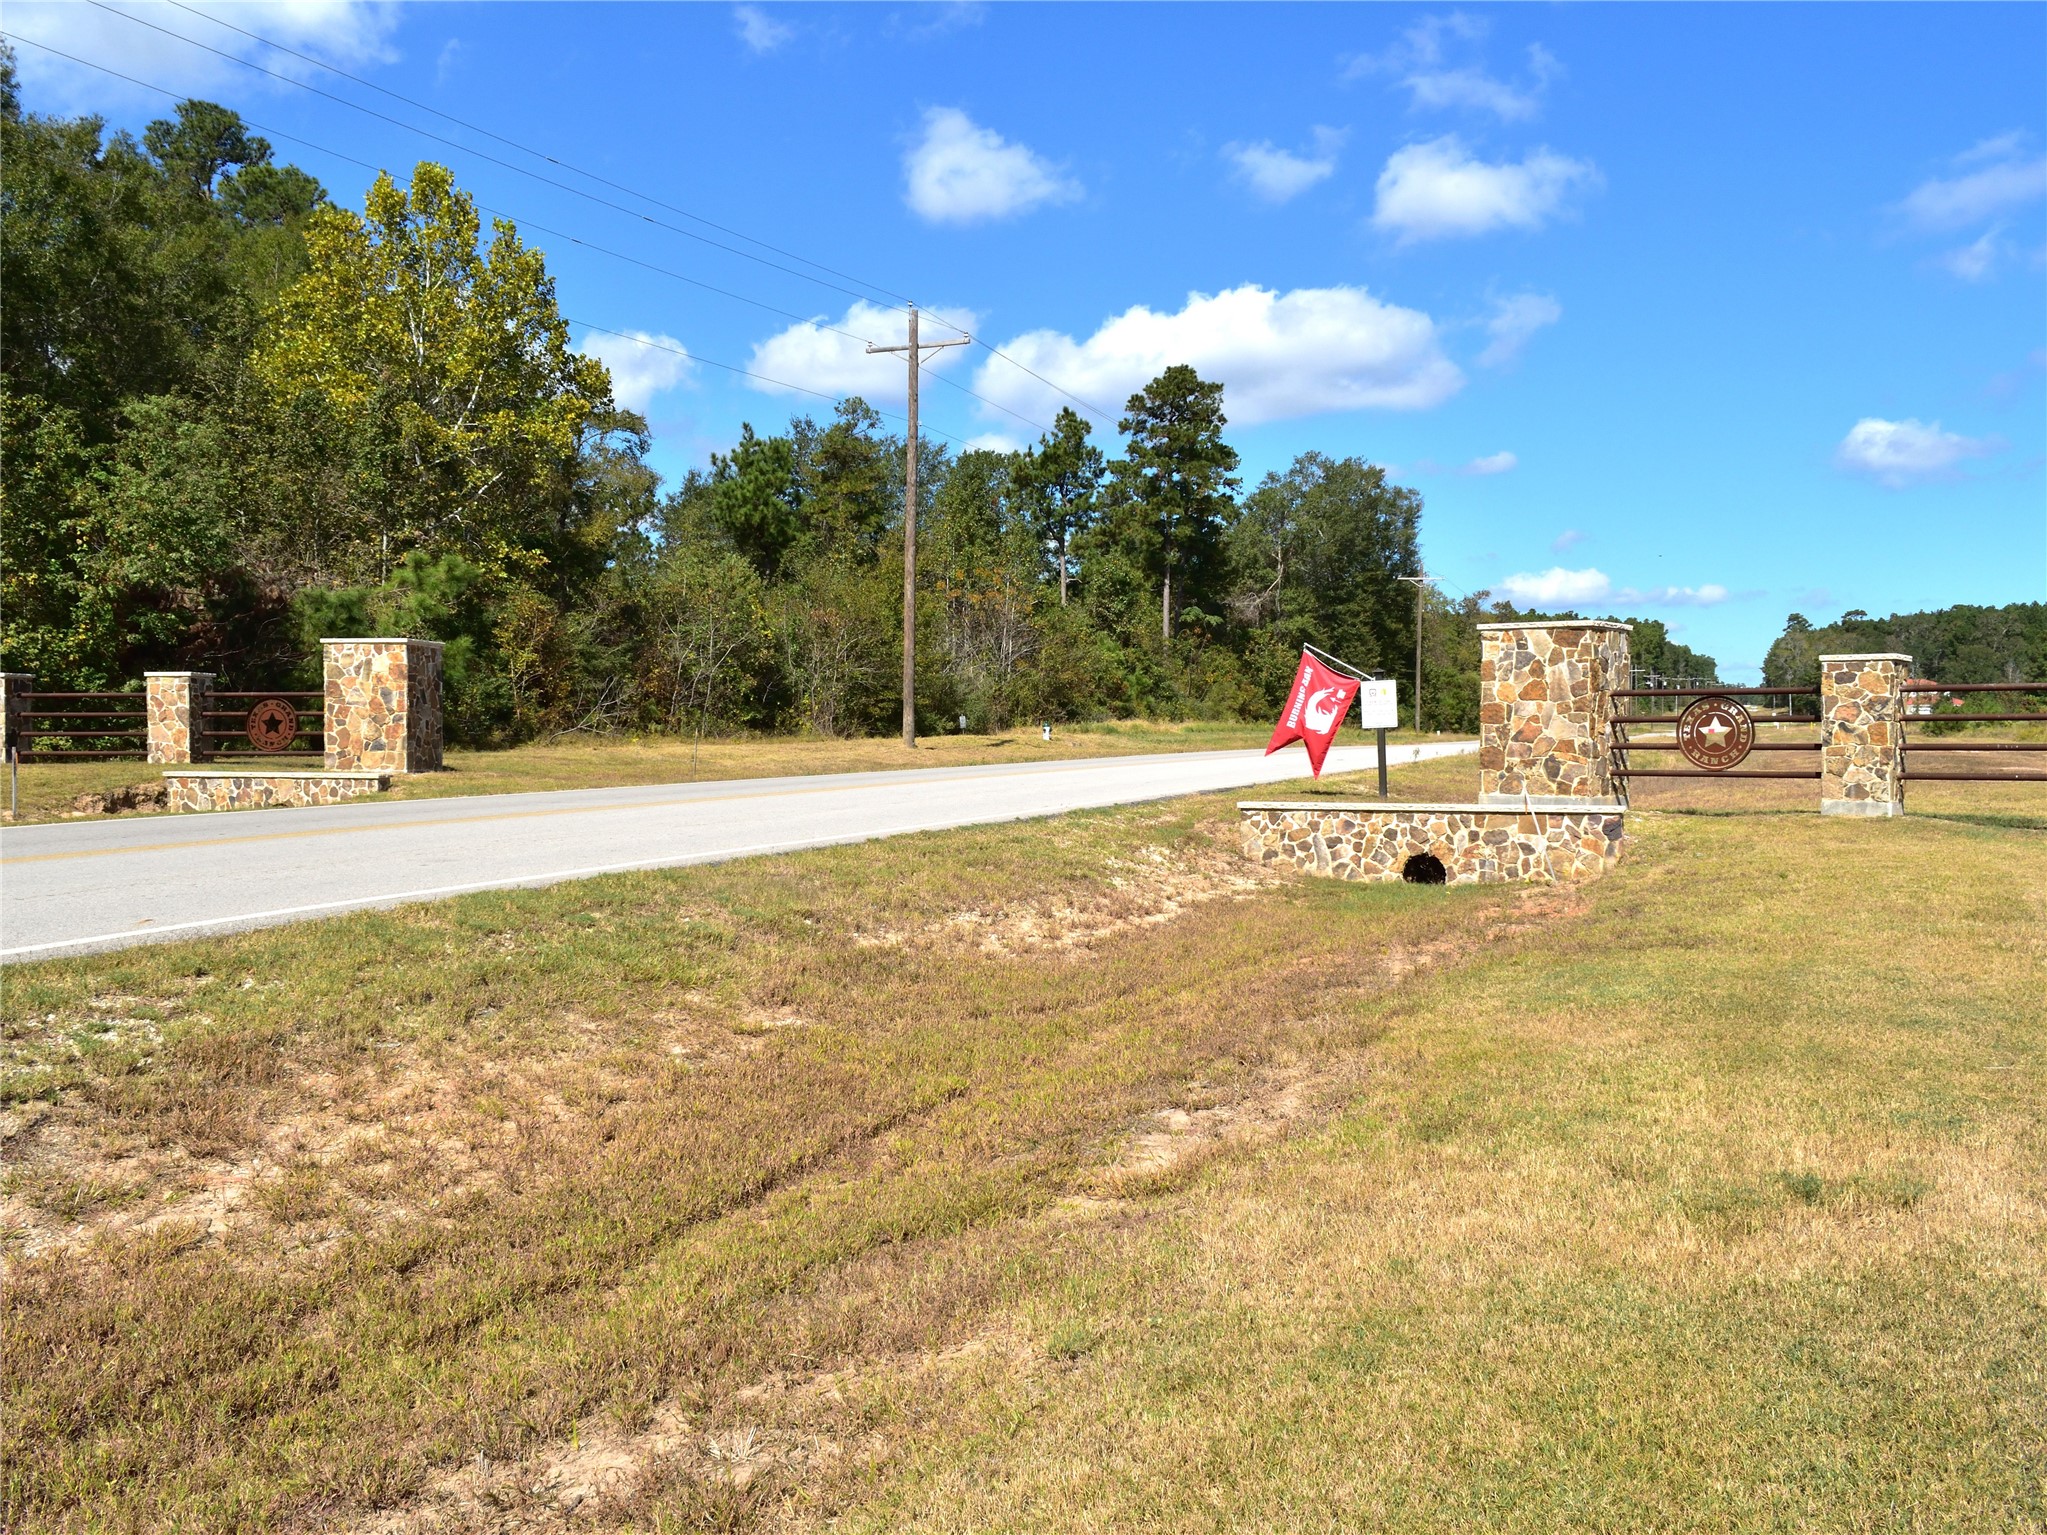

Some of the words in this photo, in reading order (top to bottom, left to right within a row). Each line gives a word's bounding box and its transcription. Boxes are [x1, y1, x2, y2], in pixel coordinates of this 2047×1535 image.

[1683, 703, 1710, 741] TEXAS
[1721, 703, 1748, 743] GRAND
[1691, 749, 1739, 765] RANCH
